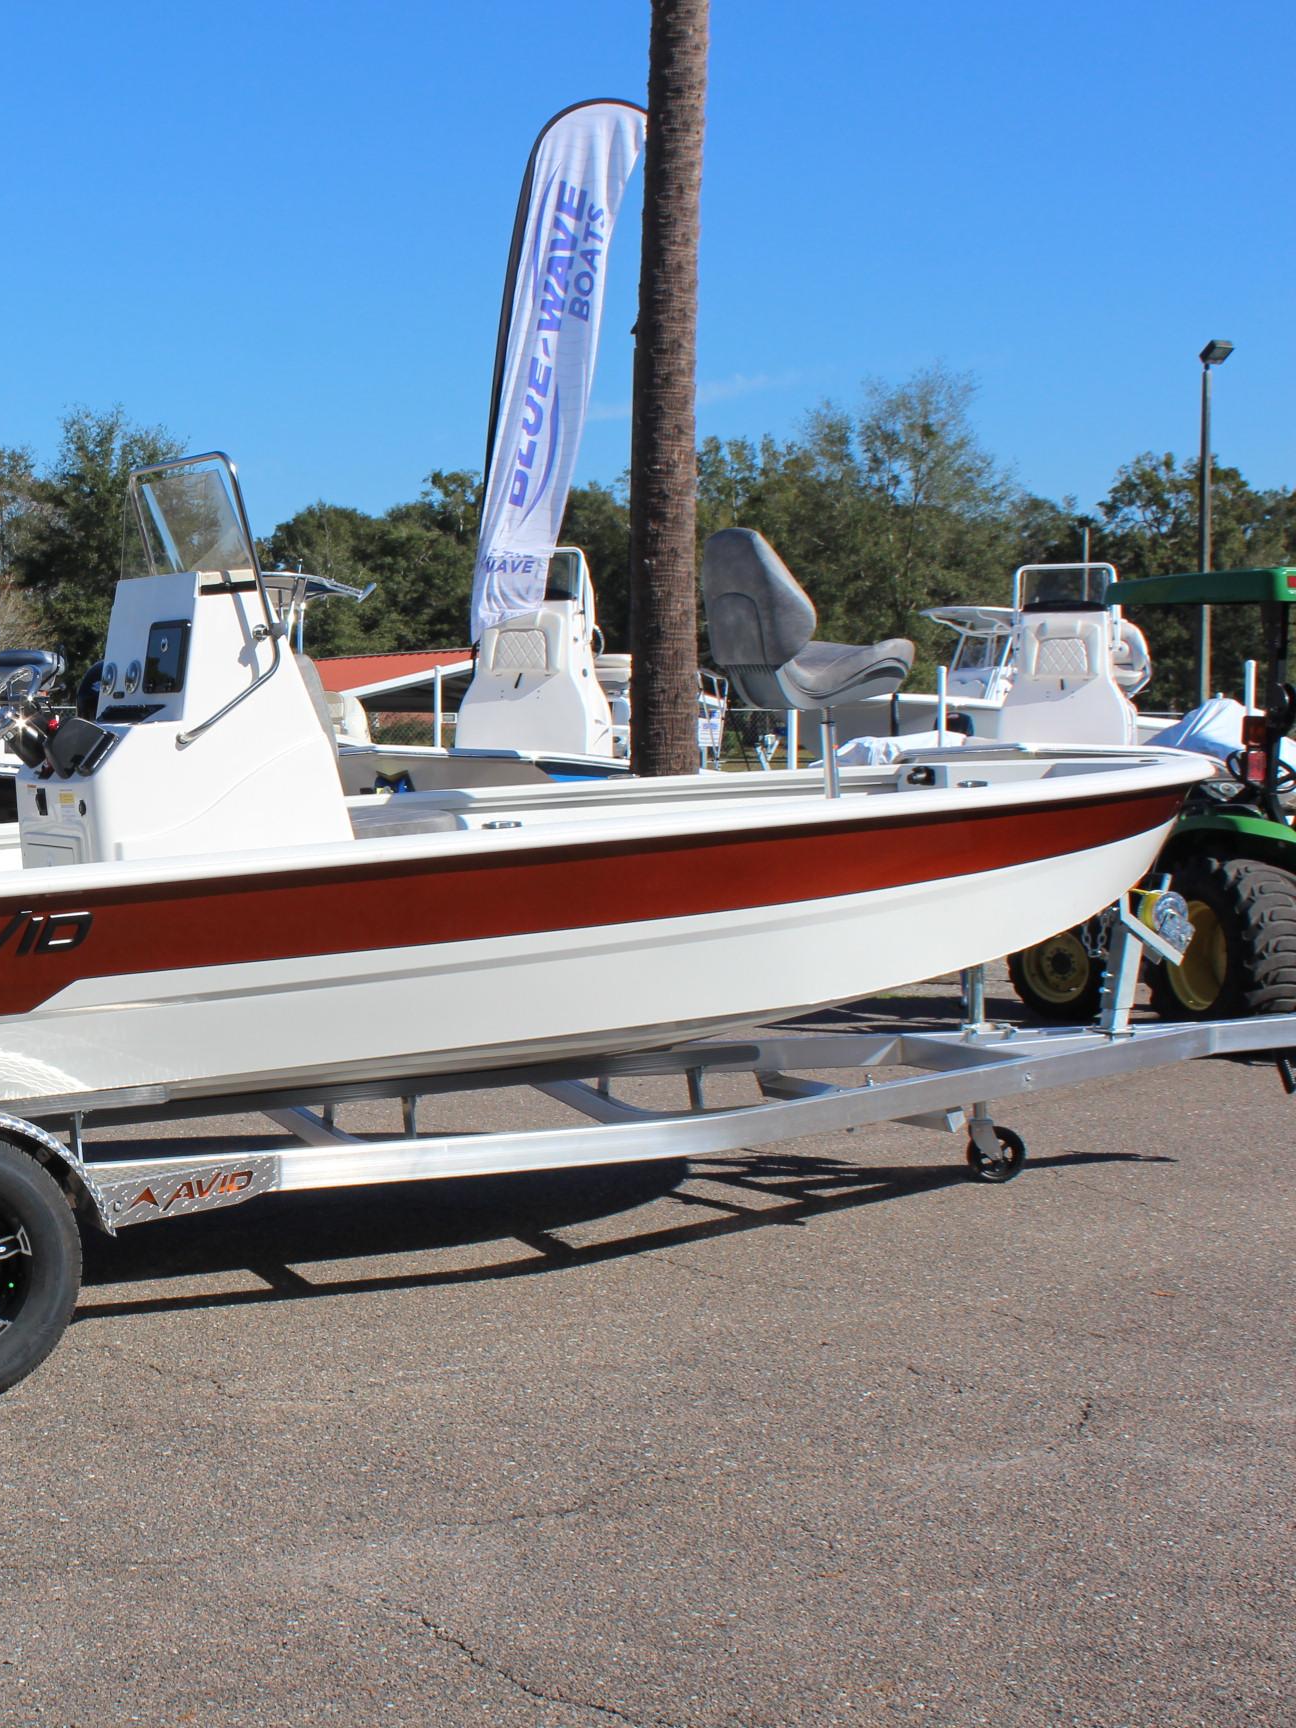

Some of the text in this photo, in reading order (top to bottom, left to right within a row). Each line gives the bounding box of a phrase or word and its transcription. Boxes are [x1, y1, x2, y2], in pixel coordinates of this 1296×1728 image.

[536, 180, 588, 331] WAVE
[568, 202, 604, 322] BOATS
[162, 1170, 254, 1212] AVID
